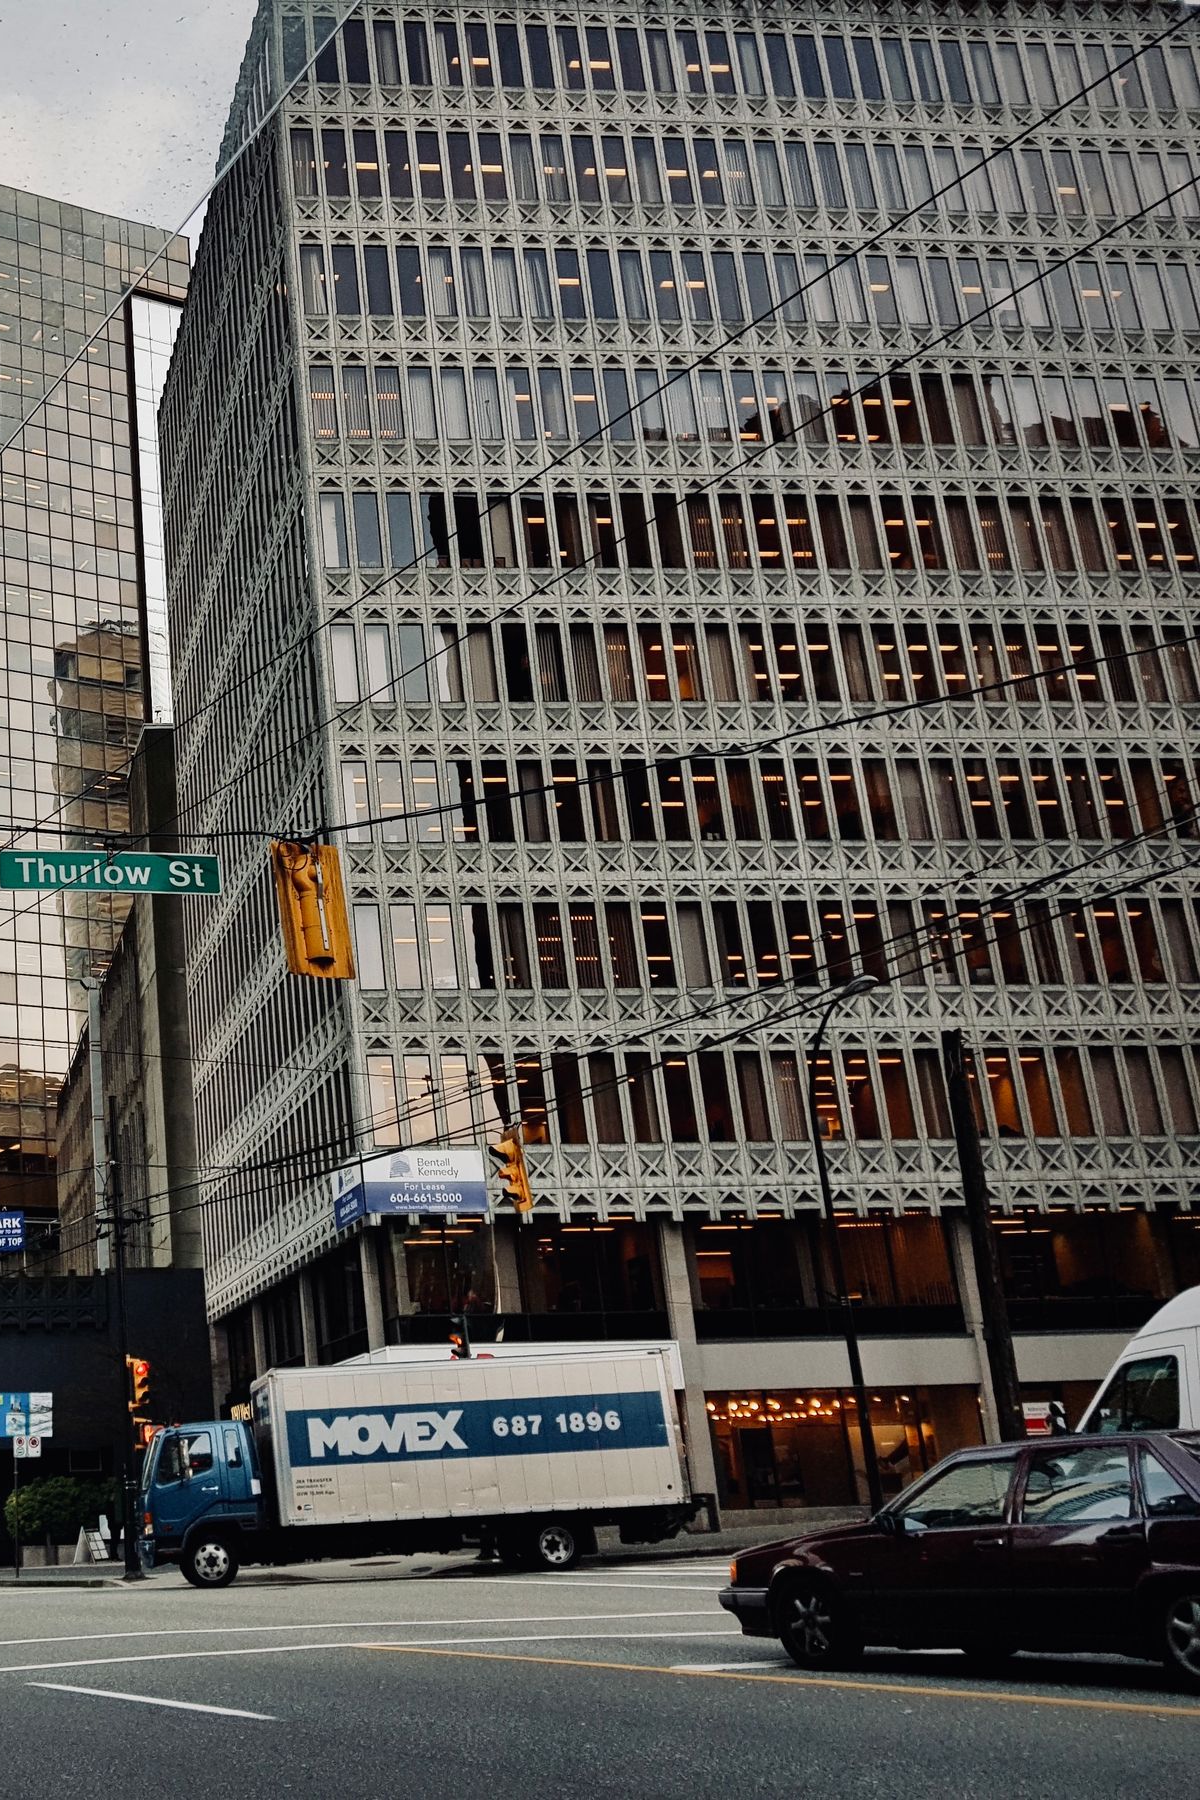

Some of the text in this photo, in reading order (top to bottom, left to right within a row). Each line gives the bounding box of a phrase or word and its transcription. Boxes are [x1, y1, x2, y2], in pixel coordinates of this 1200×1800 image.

[15, 857, 205, 887] Thurlow St
[417, 1158, 451, 1167] Bentall
[417, 1167, 459, 1179] Kennedy
[405, 1182, 446, 1191] For Lease
[390, 1193, 463, 1203] 604-661-5000
[8, 1238, 22, 1246] TOP
[307, 1410, 621, 1458] MOVEX 687 1896
